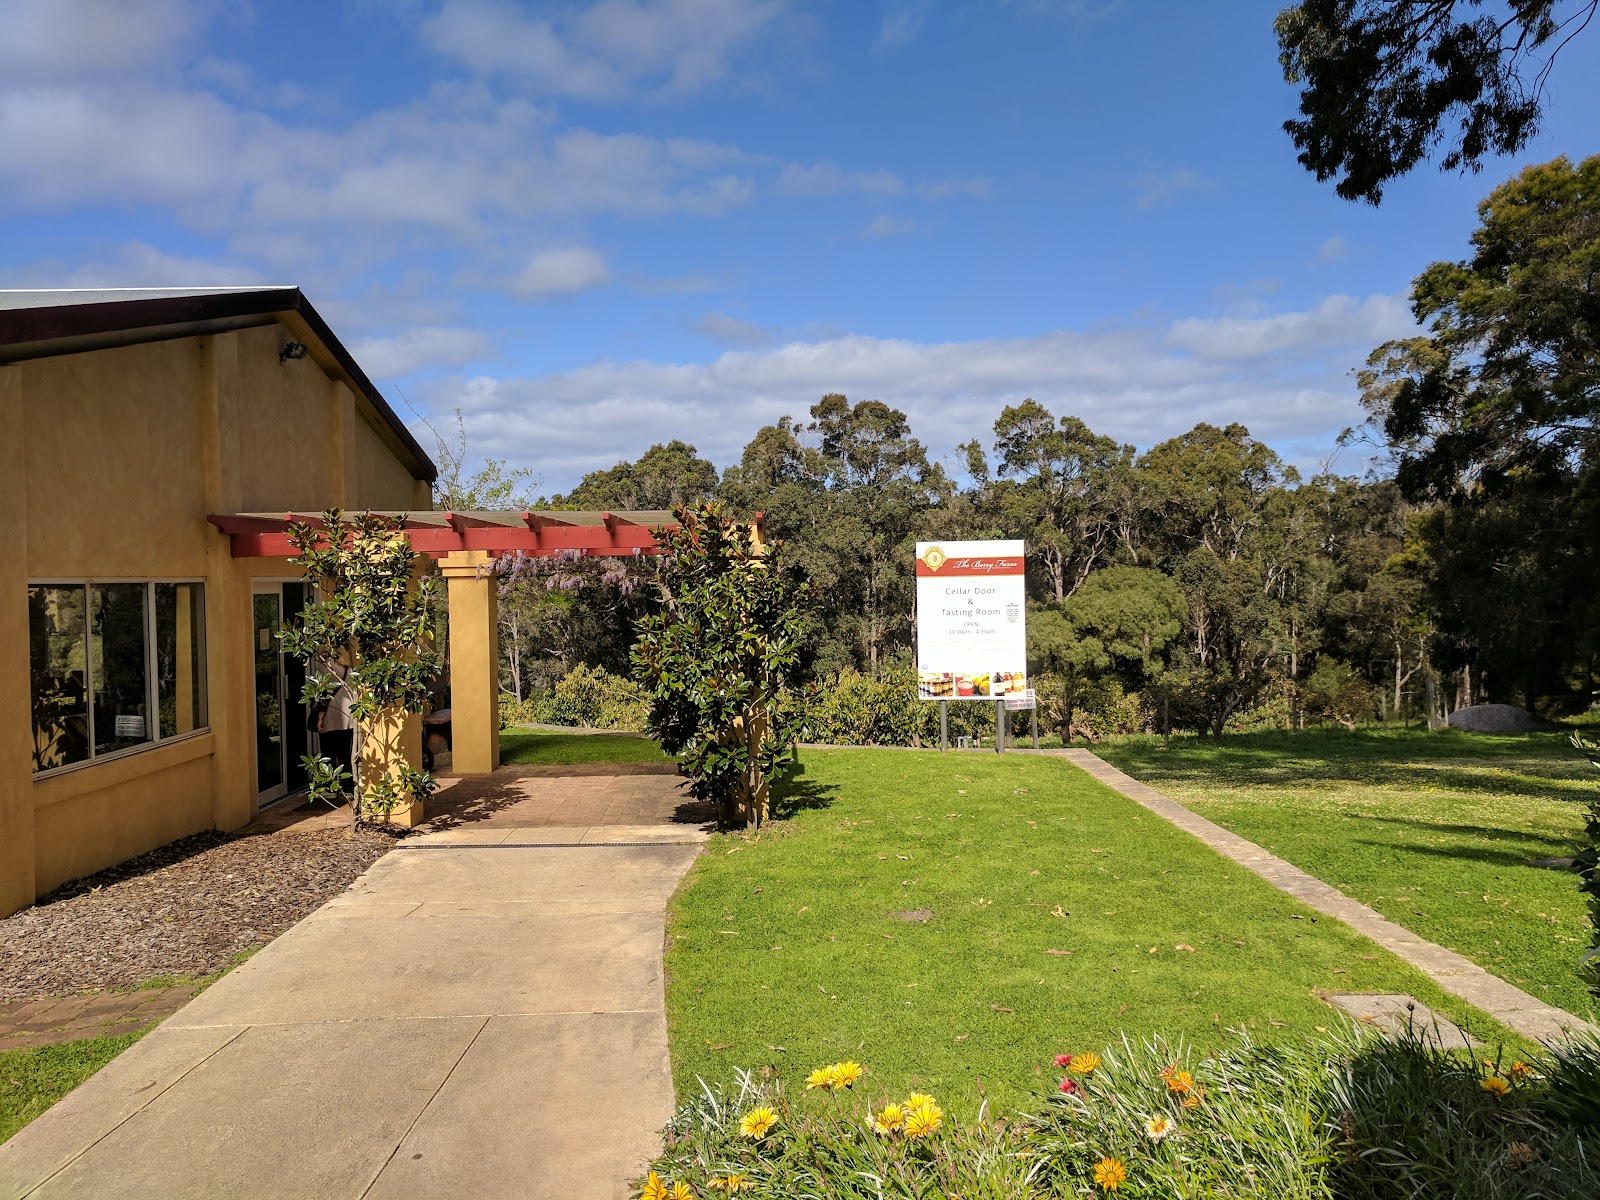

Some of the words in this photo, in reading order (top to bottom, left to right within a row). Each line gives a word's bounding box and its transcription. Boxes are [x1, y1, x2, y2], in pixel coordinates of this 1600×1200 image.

[952, 559, 970, 569] The
[970, 560, 994, 573] Berry
[995, 559, 1018, 567] Farm
[945, 587, 971, 595] Cellar
[974, 587, 996, 595] Door
[941, 608, 973, 617] Tasting
